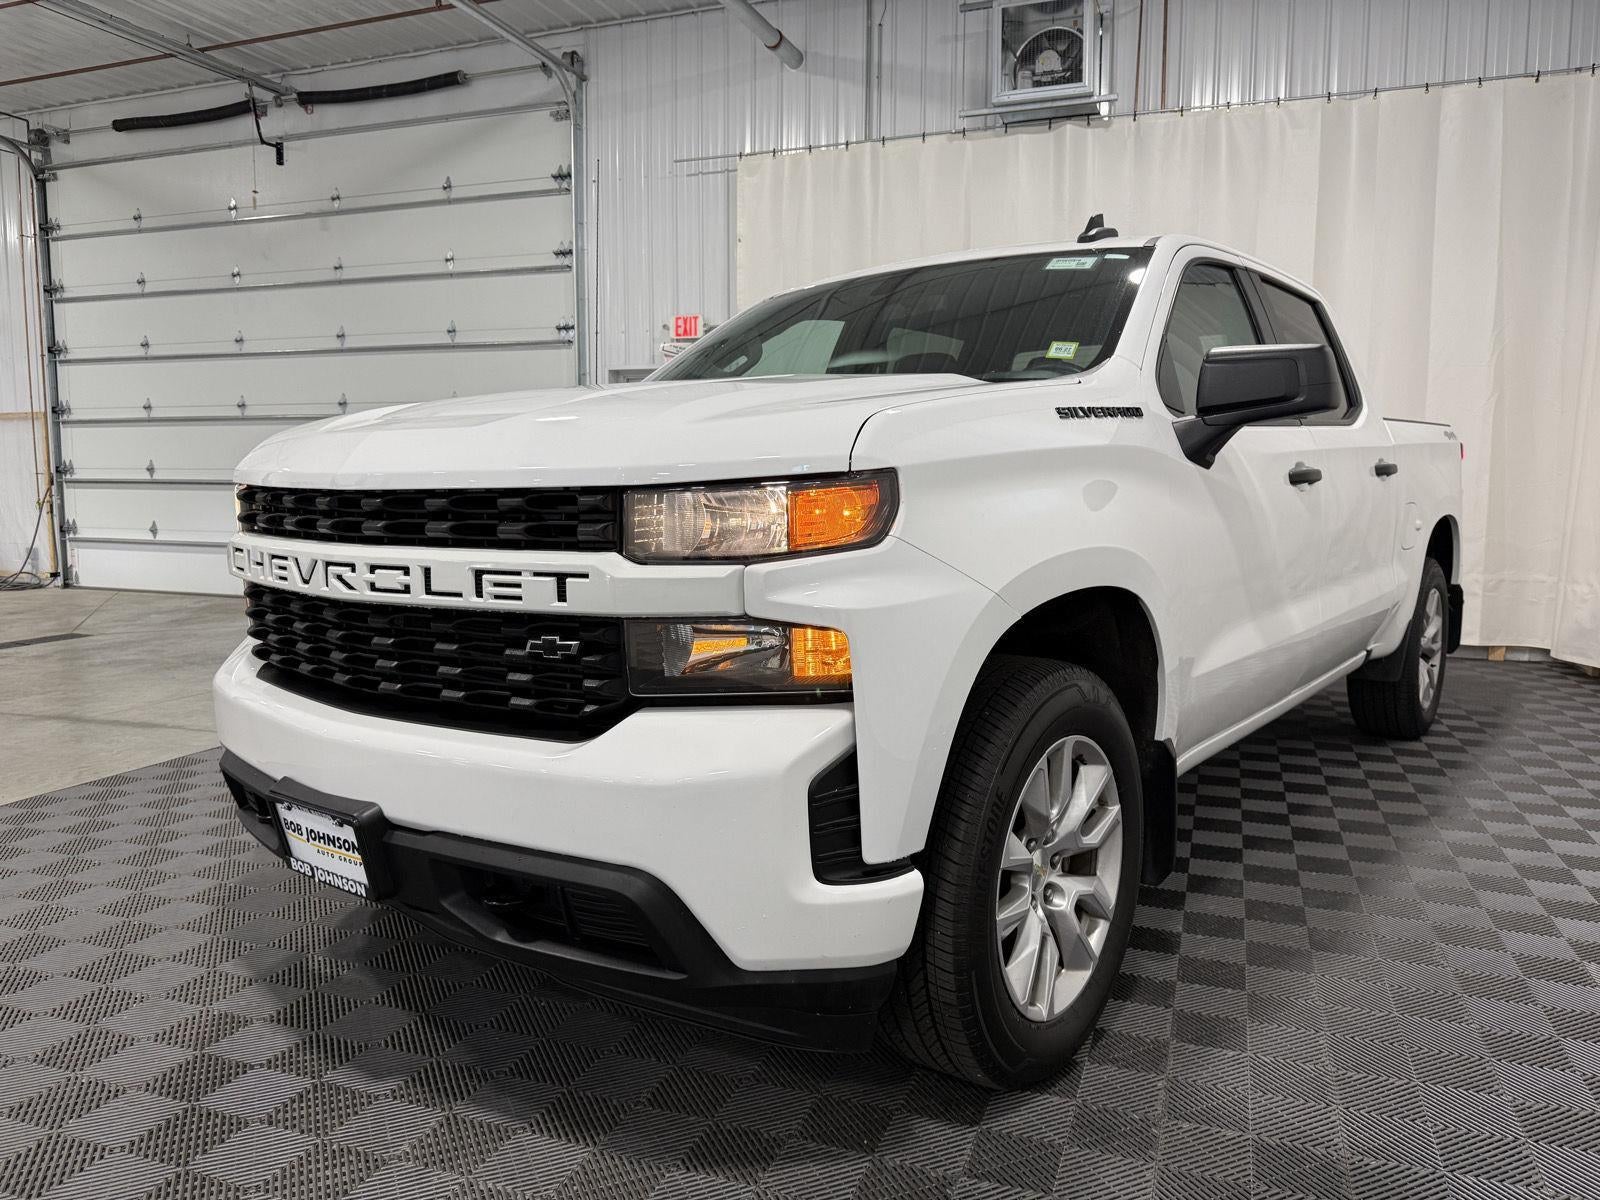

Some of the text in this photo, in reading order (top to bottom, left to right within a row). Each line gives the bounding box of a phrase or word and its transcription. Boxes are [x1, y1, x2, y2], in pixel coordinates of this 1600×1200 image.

[675, 316, 699, 337] EXIT
[230, 545, 590, 606] CHEVROLET
[283, 818, 361, 855] BOB JOHNSON
[317, 849, 363, 867] AUTO GROUP
[290, 857, 367, 897] BOB JOHNSON
